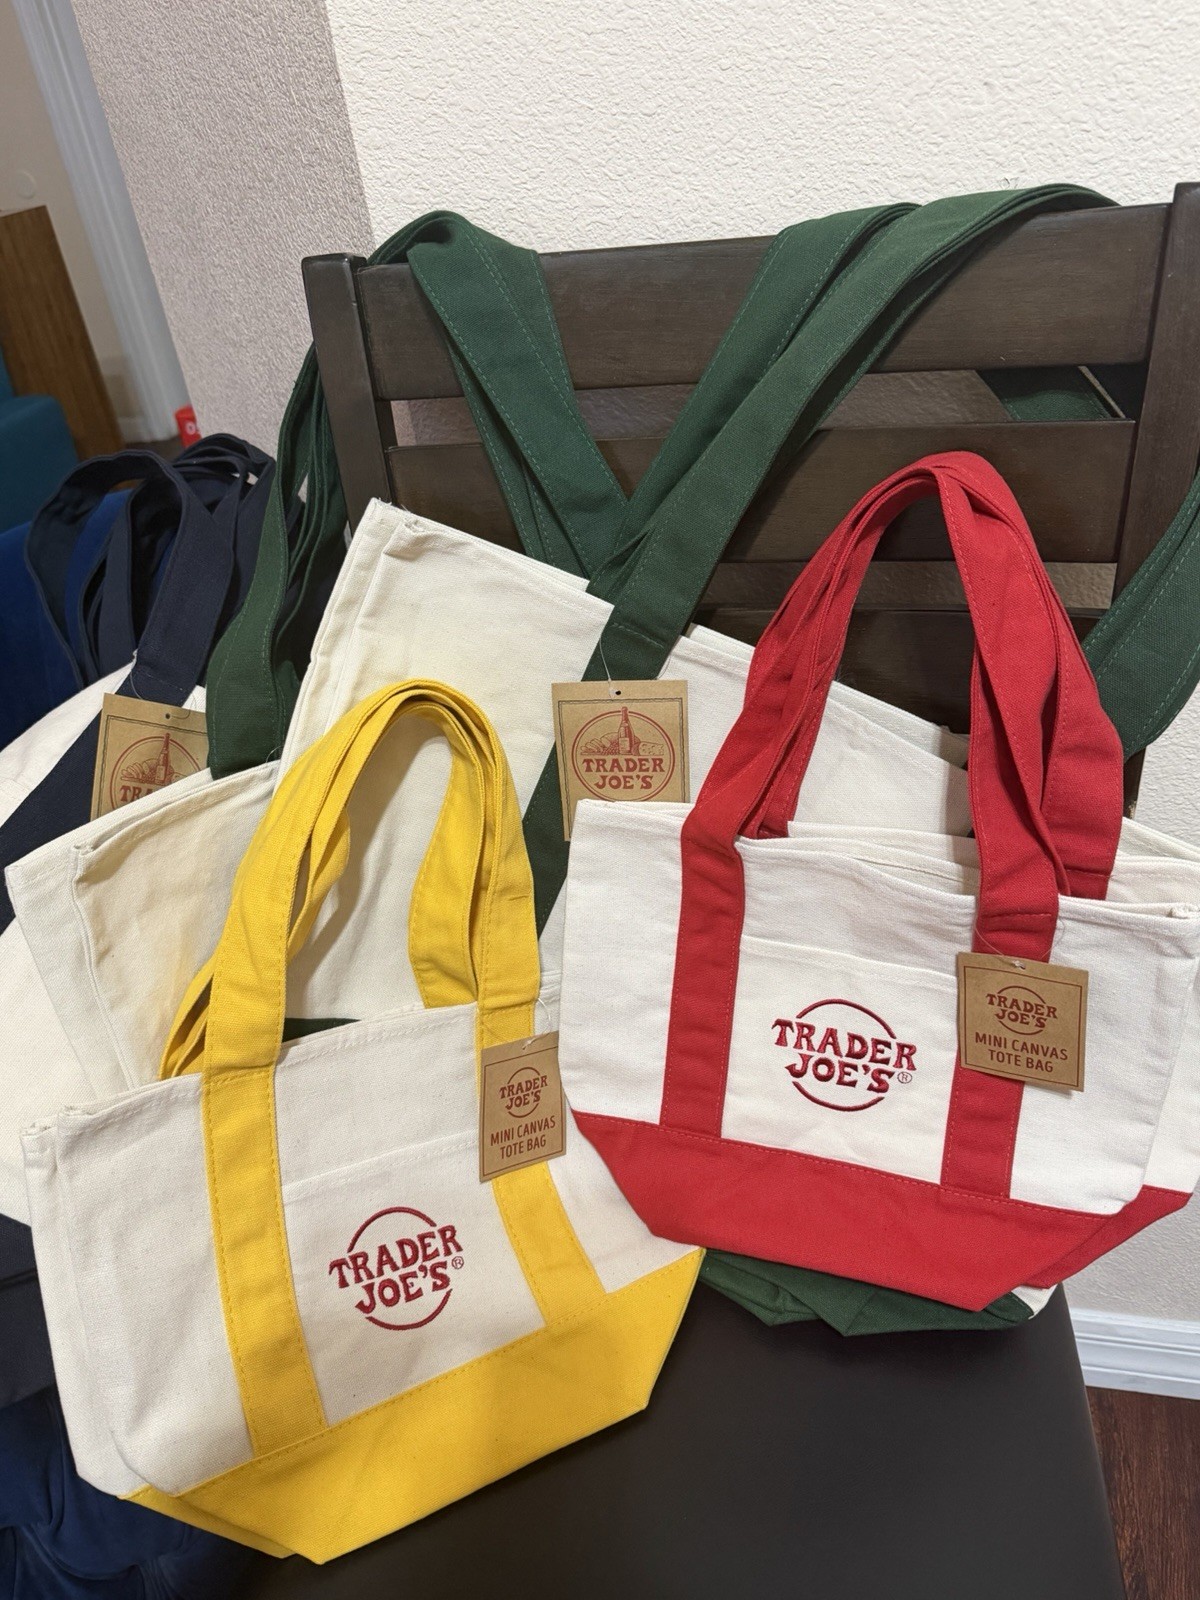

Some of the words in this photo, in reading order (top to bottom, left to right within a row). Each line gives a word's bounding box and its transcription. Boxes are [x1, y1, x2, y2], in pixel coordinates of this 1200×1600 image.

[582, 758, 665, 773] TRADER
[594, 774, 653, 790] JOE'S
[986, 993, 1058, 1019] TRADER
[995, 1009, 1047, 1029] JOE'S
[771, 1018, 917, 1071] TRADER
[975, 1032, 1007, 1049] MINI
[1011, 1039, 1068, 1061] CANVAS
[785, 1053, 896, 1094] JOE'S
[988, 1049, 1021, 1067] TOTE
[1026, 1057, 1054, 1073] BAG
[500, 1075, 548, 1099] TRADER
[505, 1089, 542, 1110] JOE'S
[490, 1127, 515, 1146] MINI
[517, 1115, 556, 1138] CANVAS
[500, 1141, 524, 1159] TOTE
[527, 1134, 546, 1152] BAG
[328, 1224, 463, 1289] TRADER
[355, 1260, 450, 1315] JOE'S
